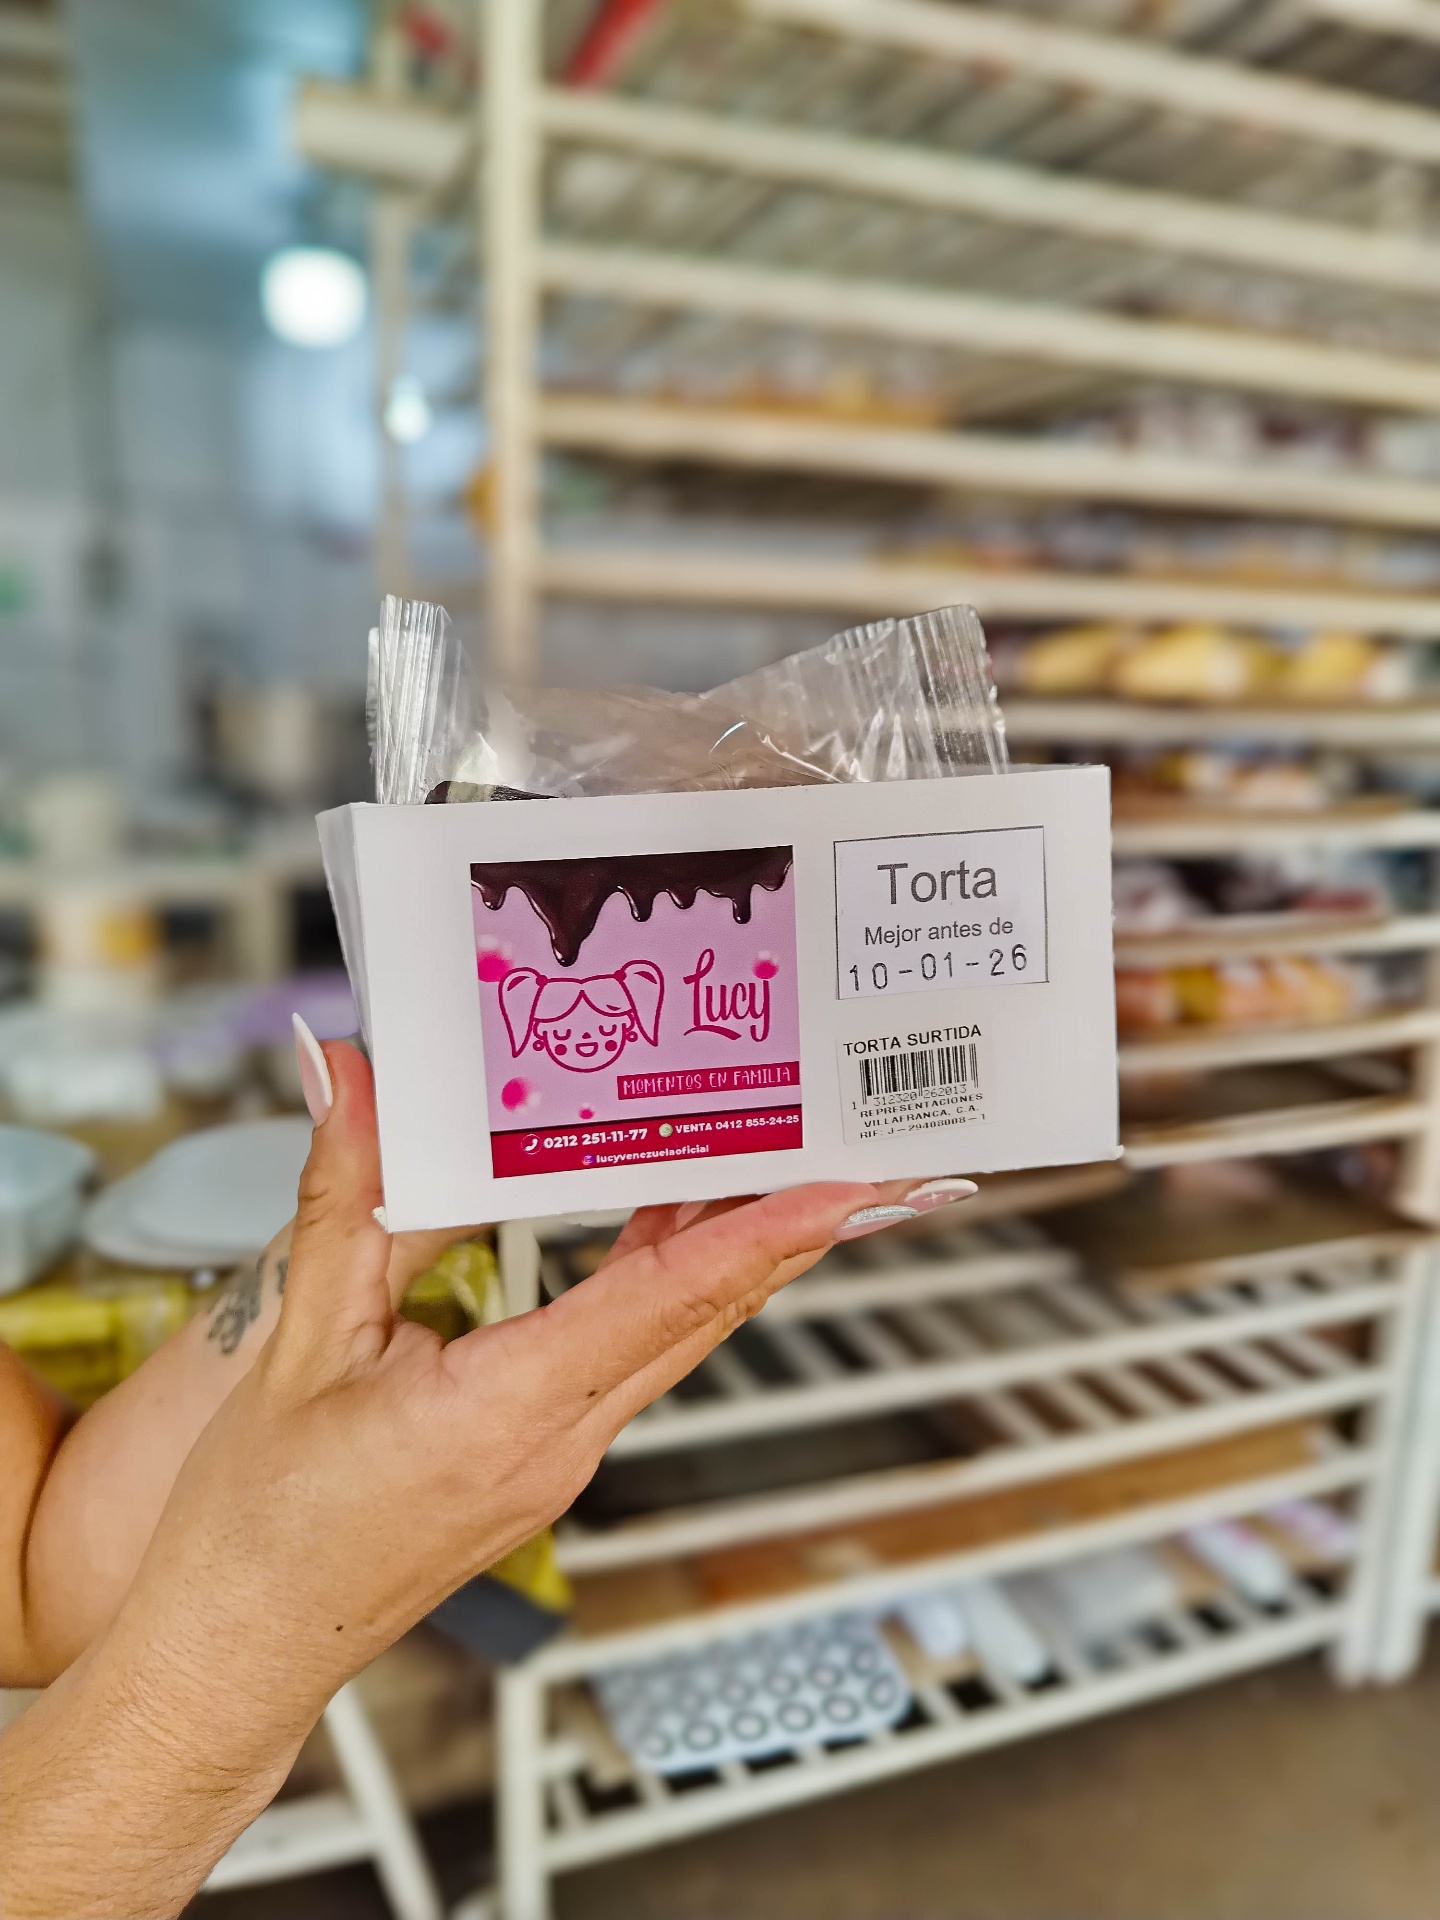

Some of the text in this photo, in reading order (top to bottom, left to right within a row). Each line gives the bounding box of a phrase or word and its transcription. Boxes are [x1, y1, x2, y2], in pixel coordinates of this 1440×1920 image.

[877, 860, 997, 905] Torta
[865, 917, 1014, 948] Mejor antes de
[683, 948, 771, 1042] Lucy
[843, 1024, 982, 1056] TORTA SURTIDA
[622, 1067, 791, 1095] MOMENTOS EN FAMILIA
[860, 1093, 983, 1118] REPRESENTACIONES
[873, 1092, 918, 1107] 312320
[923, 1084, 967, 1099] 262013
[675, 1115, 800, 1134] VENTA 0412 855-24-25
[864, 1104, 980, 1128] VILLAFRANCA, C.A.
[543, 1128, 648, 1149] 0212 251-11-77
[860, 1128, 883, 1139] RIF:
[596, 1145, 709, 1163] lucyvenezuelaoficial
